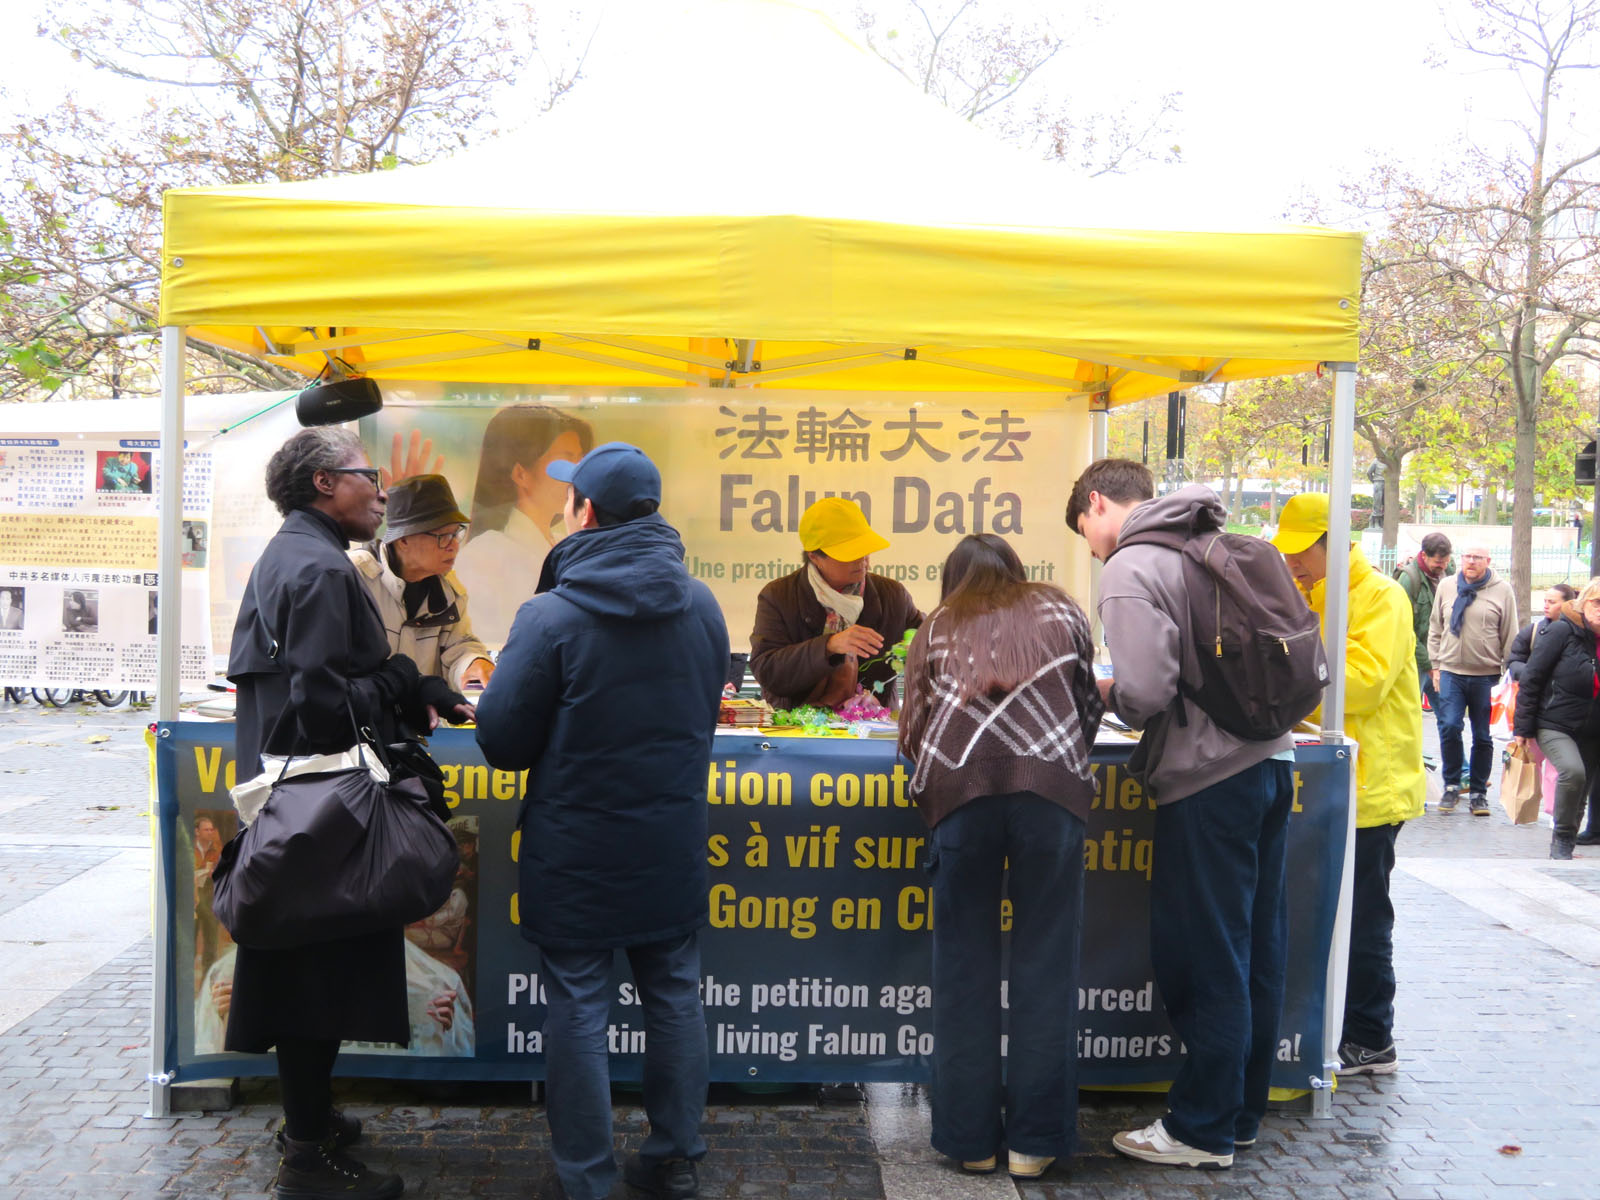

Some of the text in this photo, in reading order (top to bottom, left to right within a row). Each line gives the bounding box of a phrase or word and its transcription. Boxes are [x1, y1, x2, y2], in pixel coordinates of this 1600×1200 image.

[715, 406, 1031, 464] 法輪大法
[720, 474, 1023, 535] Faln Dafa
[684, 555, 725, 578] Une
[732, 558, 804, 583] pratiq
[868, 564, 919, 581] orps
[439, 763, 530, 809] gner
[707, 761, 792, 806] tion
[810, 765, 918, 808] cont
[745, 822, 769, 867] à
[785, 825, 841, 868] vif
[854, 836, 925, 869] sur
[1083, 829, 1153, 881] atiq
[709, 883, 819, 939] Gong
[832, 897, 882, 930] en
[751, 978, 869, 1013] petition
[717, 1023, 798, 1062] living
[808, 1024, 887, 1056] Falun
[897, 1025, 934, 1056] Go
